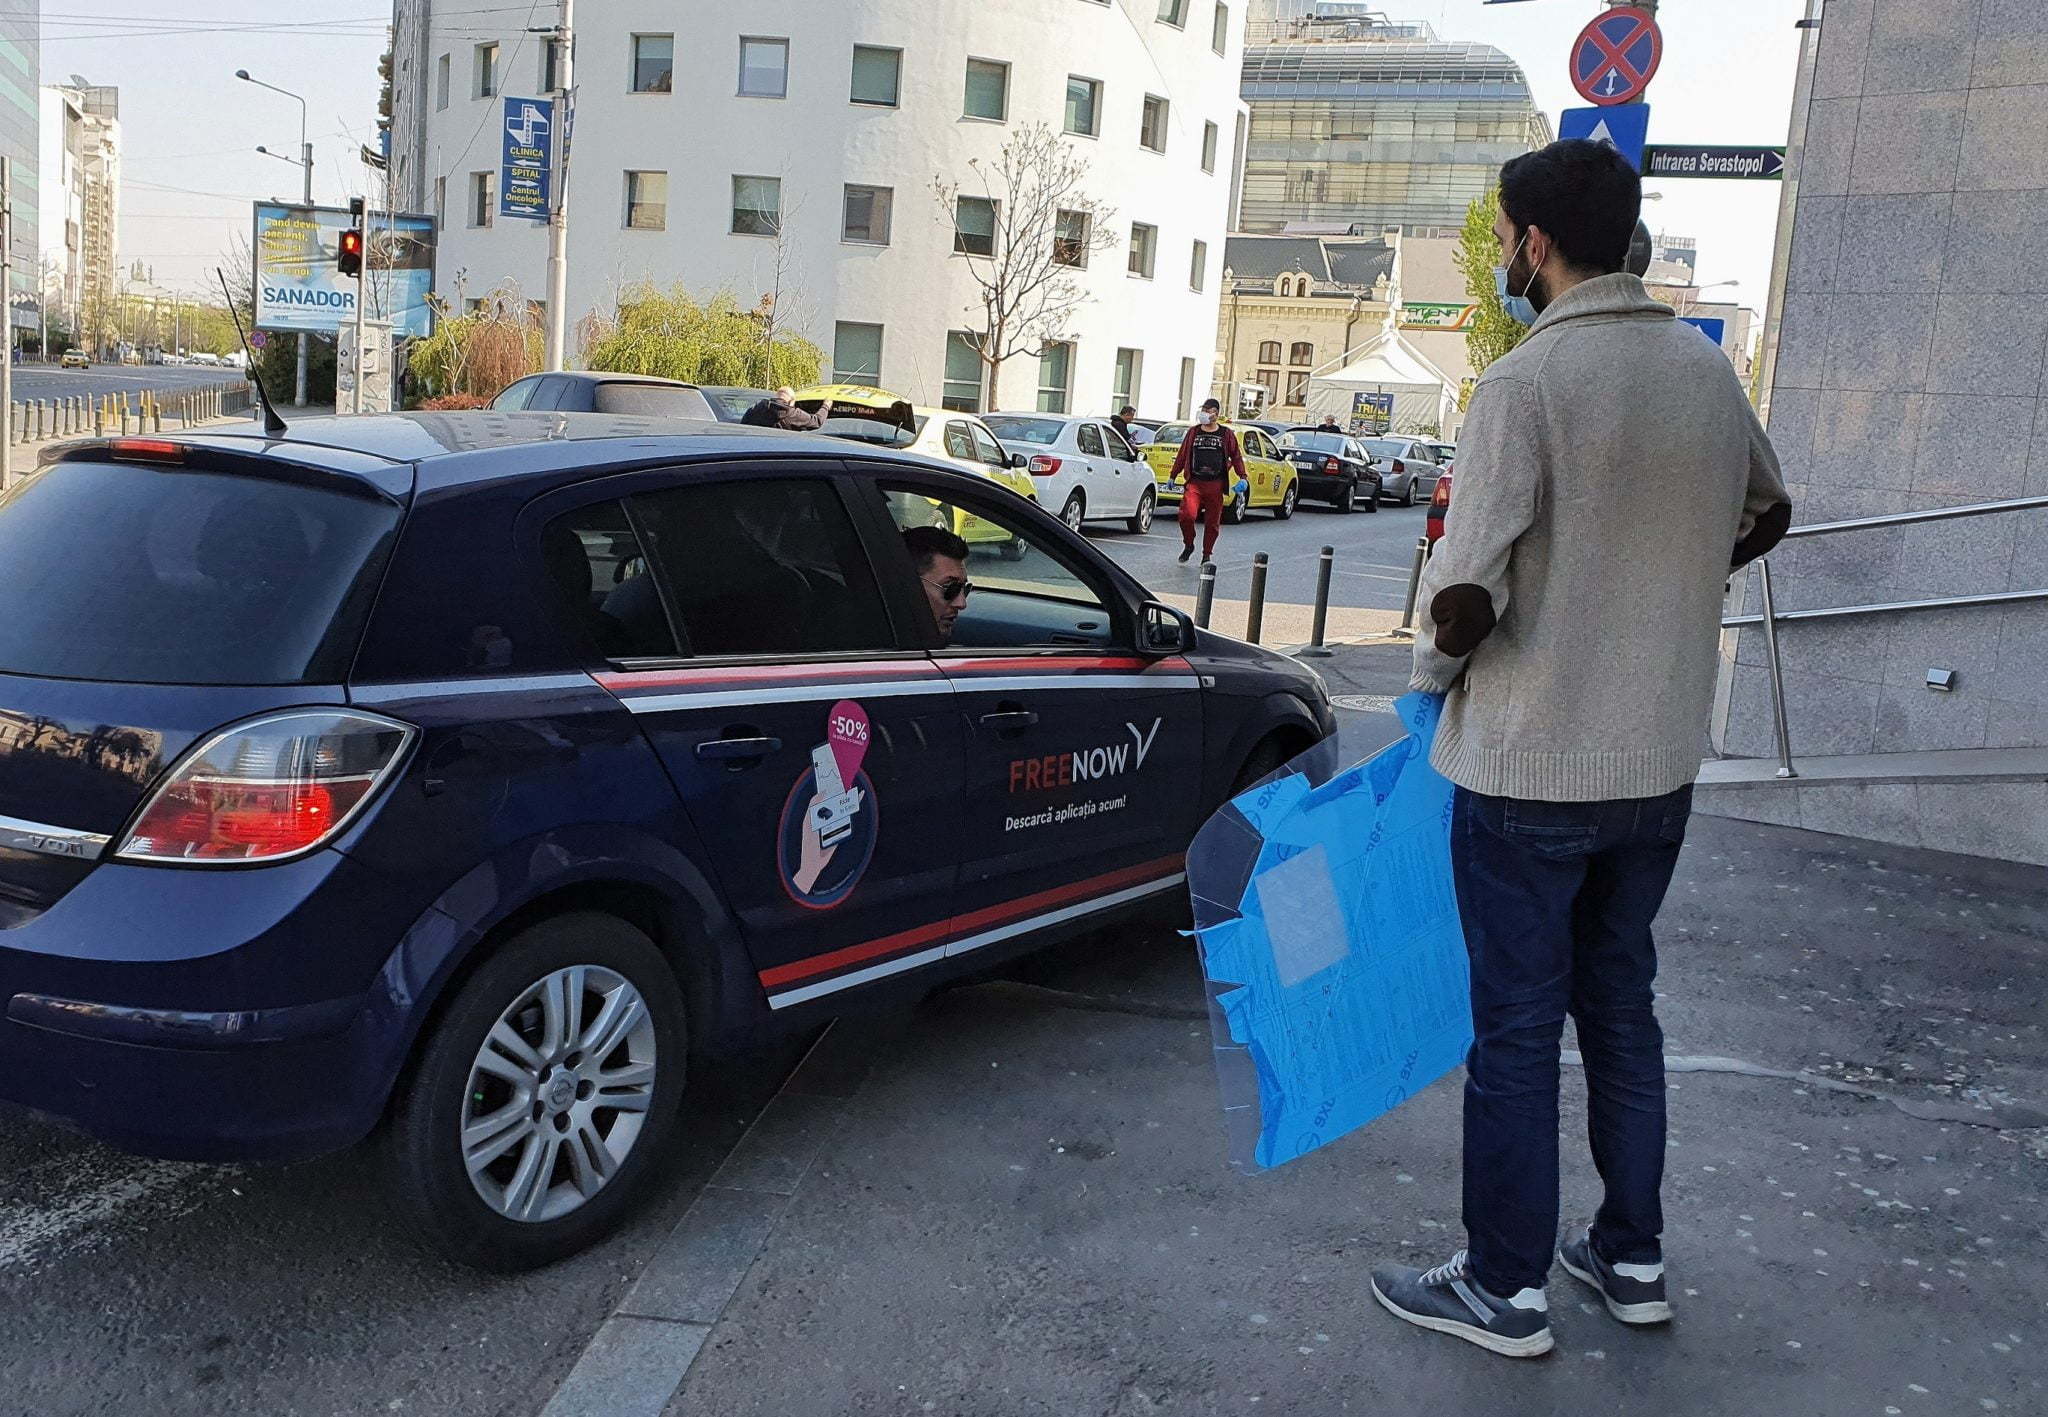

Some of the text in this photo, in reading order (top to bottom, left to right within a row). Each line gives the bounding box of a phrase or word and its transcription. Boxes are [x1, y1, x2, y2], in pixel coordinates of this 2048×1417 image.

[511, 168, 540, 178] SPITAL
[1651, 152, 1765, 176] Intrarea Sevastopol
[505, 193, 545, 205] Oncologic
[511, 185, 540, 195] Centrul
[263, 287, 355, 308] SANADOR
[831, 716, 867, 741] -50%
[1005, 794, 1127, 832] Descarcă aplicația acum!
